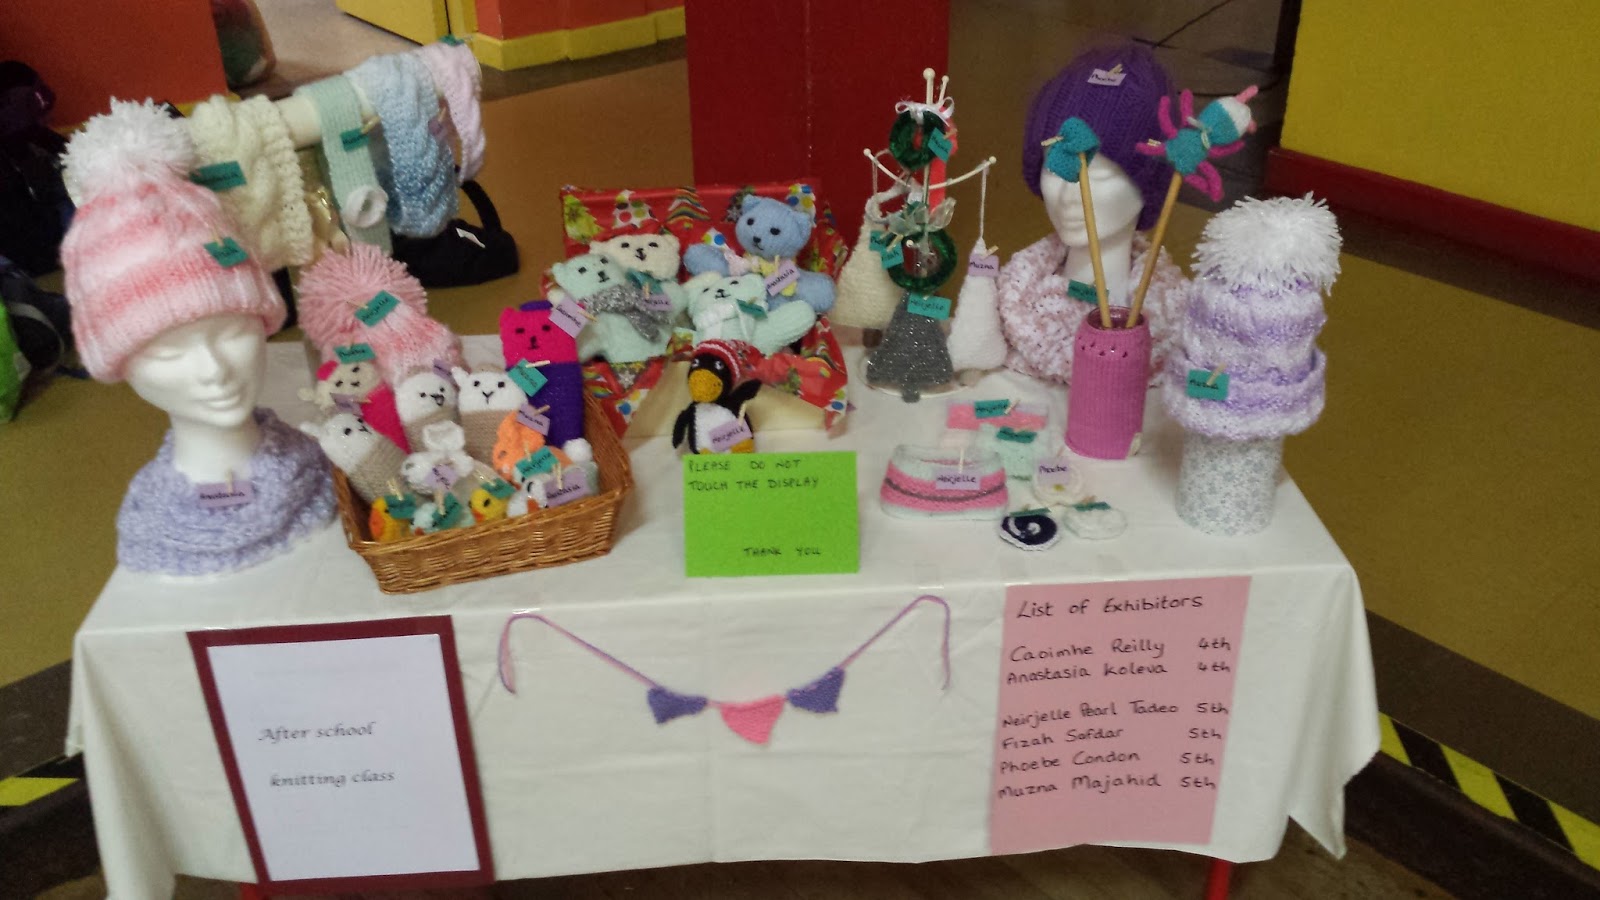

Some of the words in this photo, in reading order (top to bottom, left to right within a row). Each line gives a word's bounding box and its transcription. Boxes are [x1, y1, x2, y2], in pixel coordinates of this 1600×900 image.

[968, 260, 995, 270] Muzna
[910, 298, 945, 313] Neirjelle
[688, 459, 731, 473] PLEASE
[750, 460, 766, 471] DO
[775, 458, 802, 470] NOT
[688, 480, 729, 492] TOUCH
[736, 478, 758, 490] THE
[767, 475, 820, 490] DISPLAY
[937, 475, 977, 486] Neirjelle
[743, 546, 782, 558] THANK
[793, 545, 822, 557] YOU
[1016, 600, 1054, 619] List
[1068, 598, 1091, 615] of
[1102, 595, 1204, 614] Exhibitors
[1009, 644, 1094, 663] Caoimhe
[1111, 637, 1166, 660] Reilly
[1198, 637, 1232, 652] 4th
[1006, 664, 1092, 686] Anastasia
[1197, 659, 1231, 673] 4th
[1002, 708, 1071, 729] Neirjelle
[1078, 701, 1118, 718] Pearl
[1129, 699, 1180, 715] Tadeo
[1196, 702, 1230, 715] 5th
[257, 725, 311, 744] After
[316, 721, 377, 738] school
[1001, 732, 1055, 751] Fizah
[1188, 727, 1223, 740] 5th
[999, 756, 1061, 775] Phoebe
[1072, 750, 1141, 767] Condon
[1179, 752, 1216, 765] 5th
[269, 770, 347, 788] knitting
[351, 768, 396, 783] class
[997, 782, 1059, 799] Muzna
[1071, 773, 1163, 794] Majahid
[1180, 776, 1216, 790] 5th
